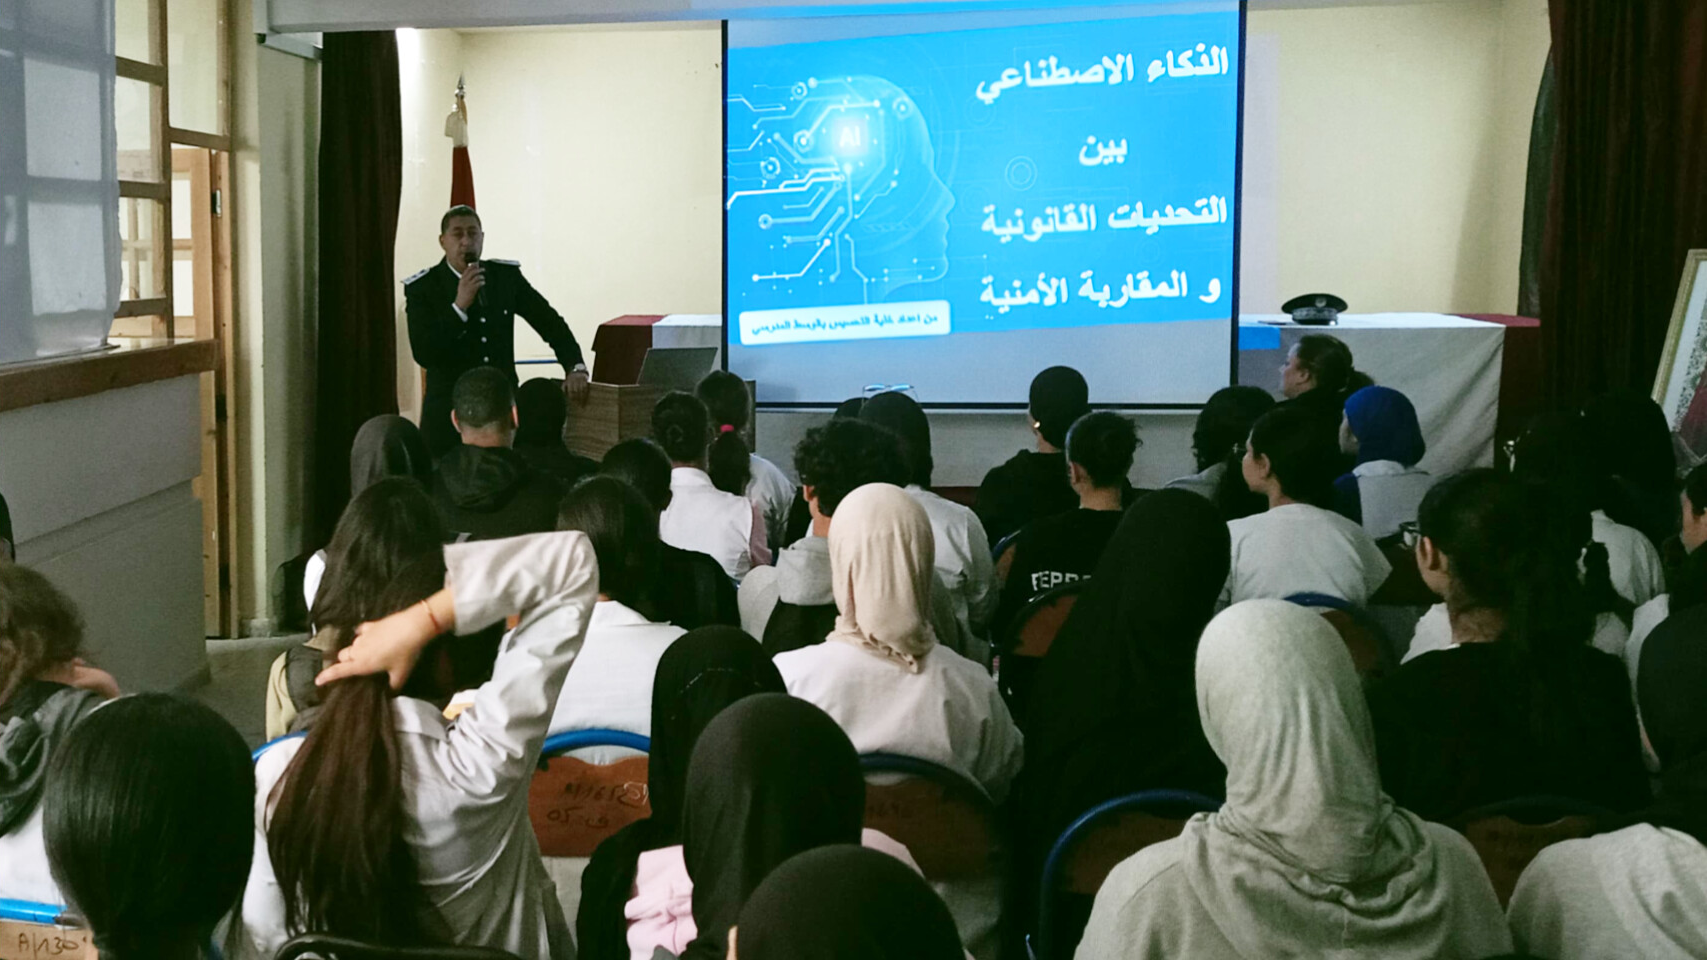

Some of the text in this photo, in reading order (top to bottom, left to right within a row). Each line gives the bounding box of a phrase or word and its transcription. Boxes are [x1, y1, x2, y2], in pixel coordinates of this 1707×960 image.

[975, 42, 1230, 105] الذكاء الاصطناعي
[1078, 134, 1129, 166] بين
[980, 194, 1229, 244] التحديات القانونية
[979, 269, 1222, 314] و المقاربة الأمنية
